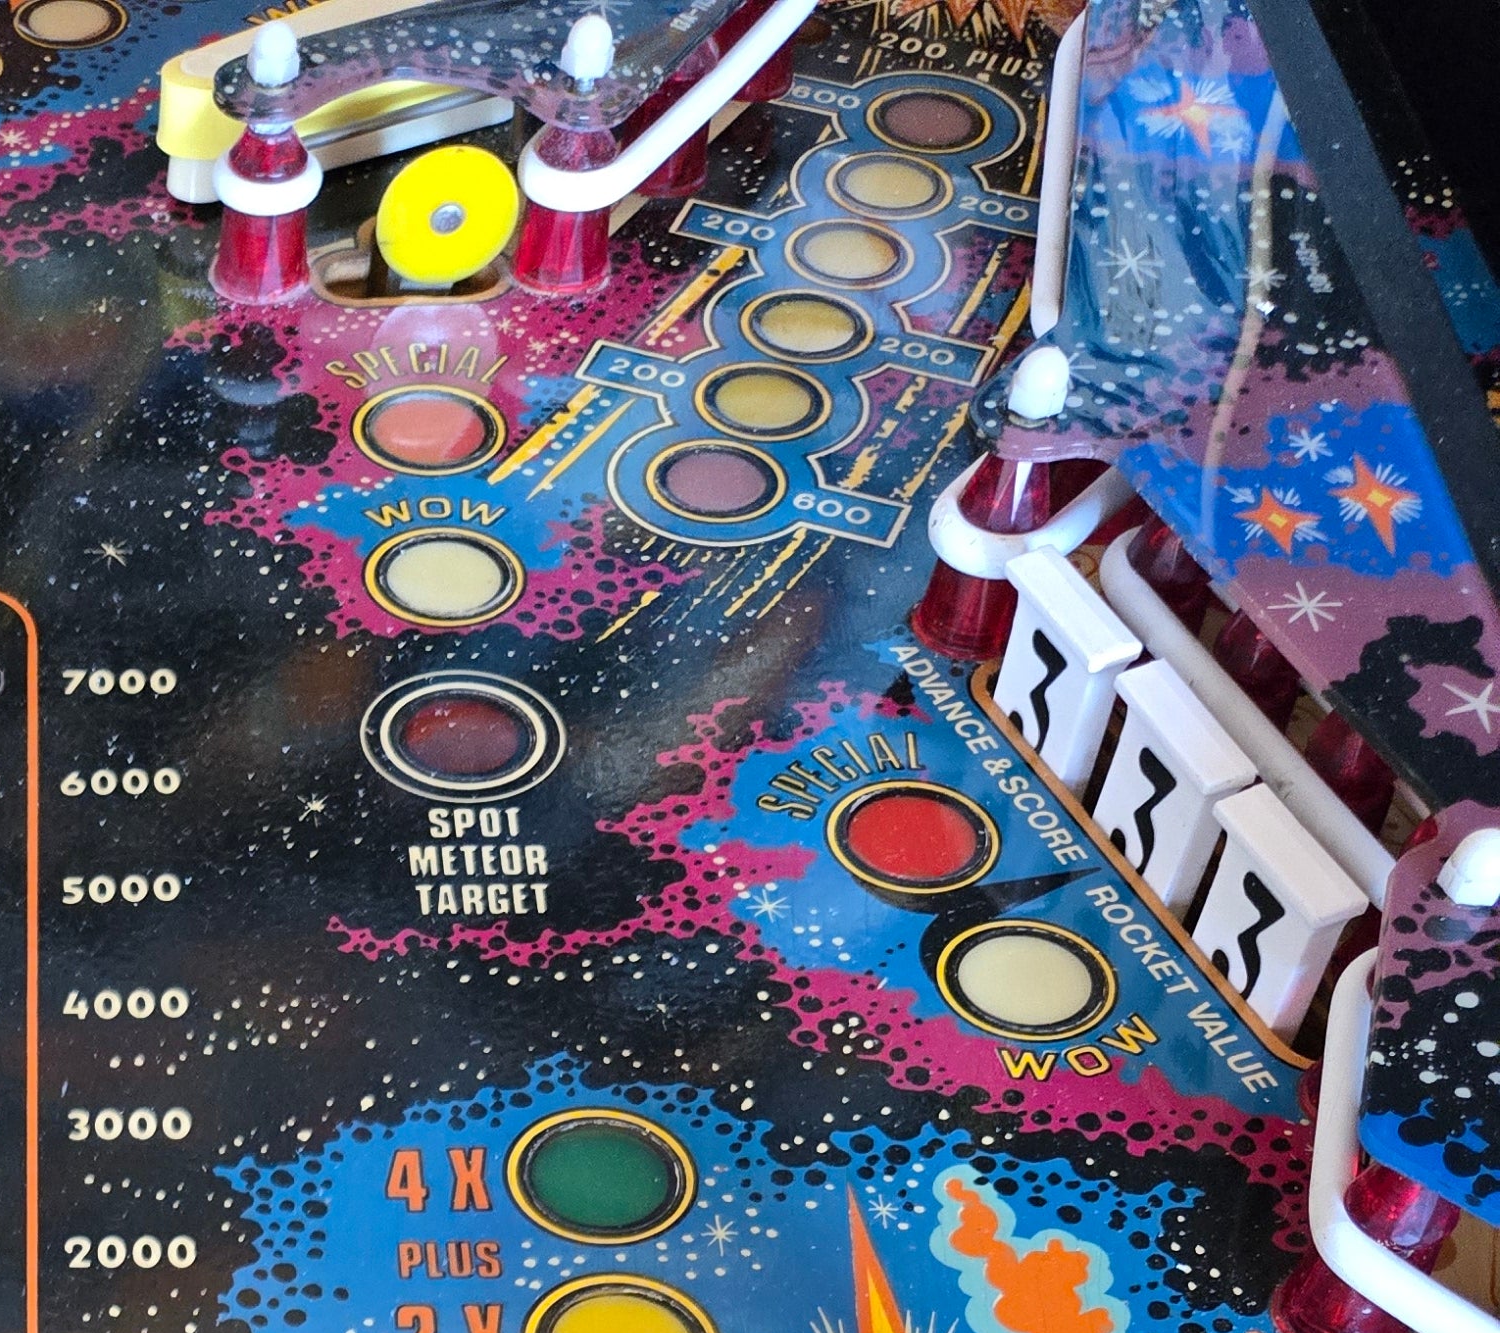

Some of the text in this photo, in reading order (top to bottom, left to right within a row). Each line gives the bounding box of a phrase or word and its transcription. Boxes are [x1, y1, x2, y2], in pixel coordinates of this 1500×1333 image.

[876, 33, 1044, 79] 200 PLUS
[791, 85, 861, 110] 600
[958, 197, 1031, 221] 200
[702, 214, 776, 241] 200
[325, 342, 510, 389] SPECIAL
[878, 337, 955, 365] 200
[608, 358, 686, 387] 200
[366, 495, 505, 529] WOW
[793, 493, 871, 525] 600
[61, 667, 178, 697] 7000
[59, 767, 182, 798] 6000
[756, 730, 926, 822] SPECIAL
[427, 805, 521, 839] SPOT
[407, 843, 550, 878] METEOR
[890, 644, 1278, 1095] ADVANCE & SCORE ROCKET VALUE
[61, 873, 182, 906] 5000
[414, 881, 550, 917] TARGET
[61, 986, 191, 1021] 4000
[999, 1013, 1160, 1083] WOW
[66, 1106, 193, 1142] 3000
[386, 1147, 490, 1211] 4 X
[63, 1234, 198, 1270] 2000
[399, 1240, 501, 1279] PLUS
